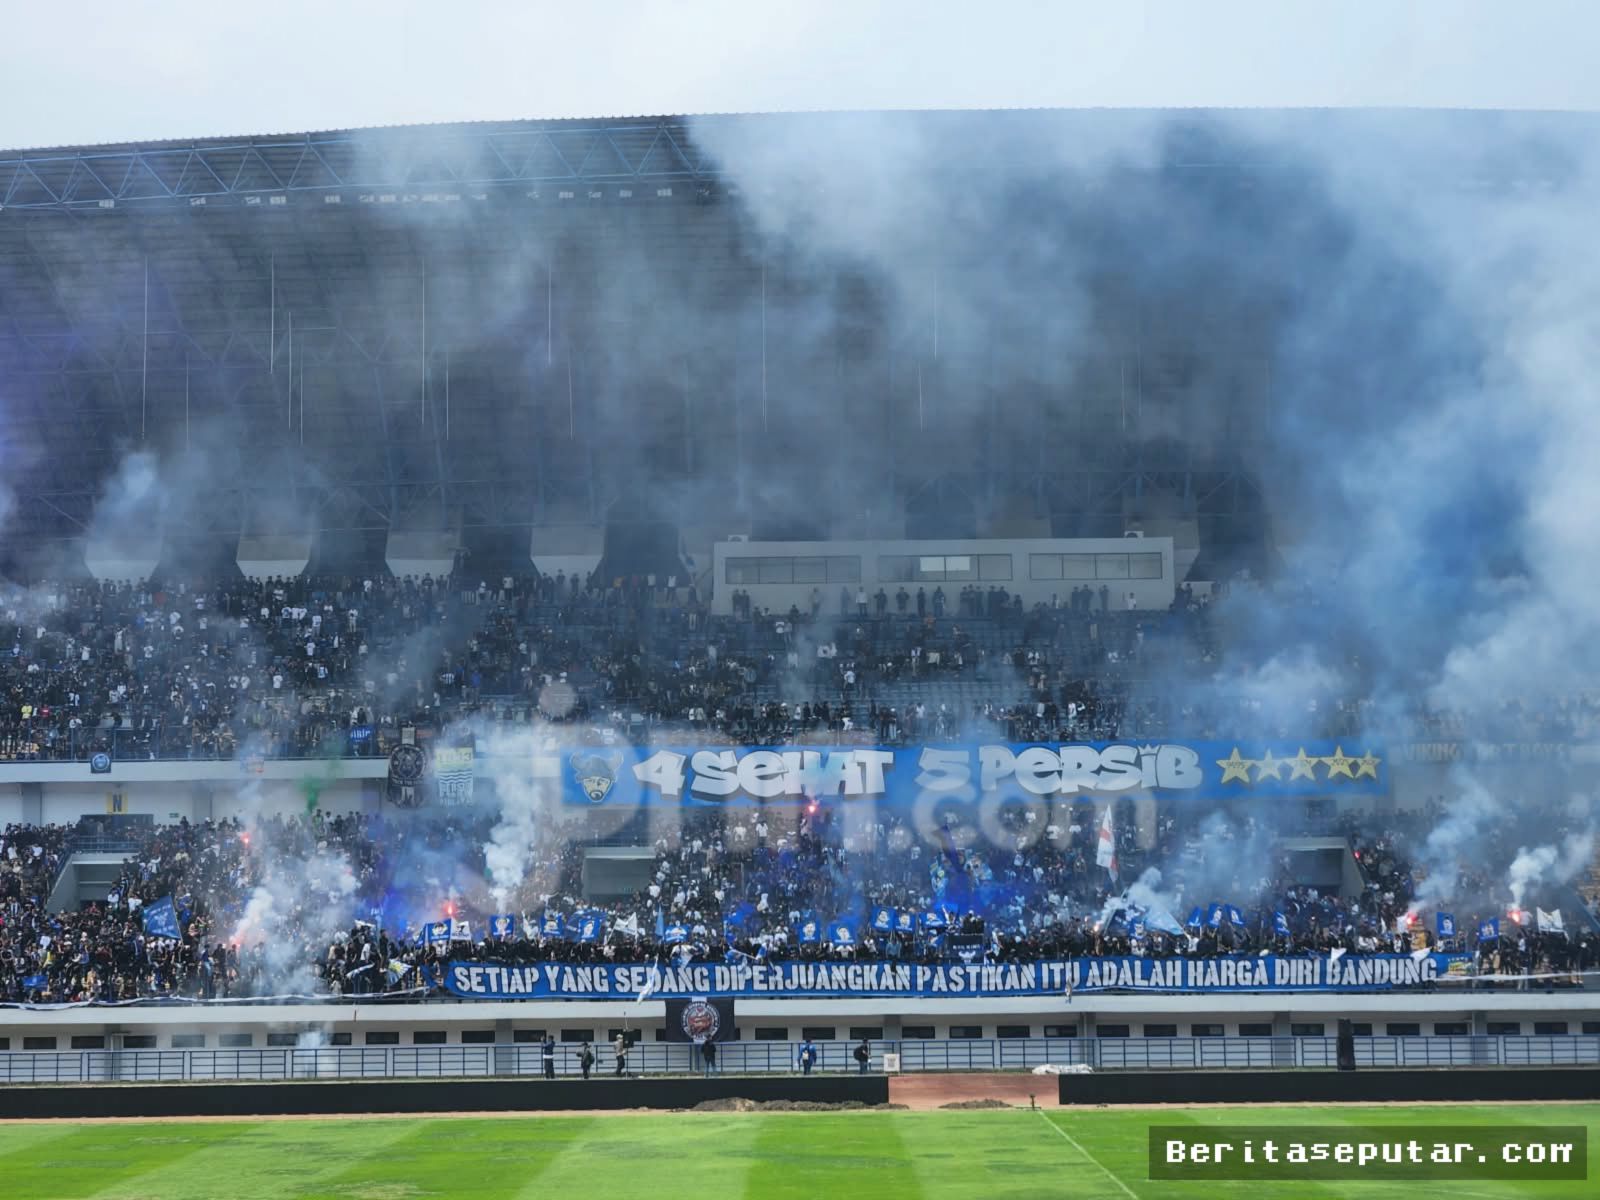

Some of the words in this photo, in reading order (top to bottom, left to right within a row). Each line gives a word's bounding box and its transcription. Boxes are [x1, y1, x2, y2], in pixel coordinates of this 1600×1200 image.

[632, 750, 687, 796] 4
[914, 747, 969, 791] 5
[454, 966, 540, 994] SETIAP
[544, 965, 609, 993] YANG
[615, 966, 710, 993] SEDANG
[715, 963, 910, 992] DIPERJUANGKAN
[916, 964, 1036, 992] PASTIKAN
[1042, 961, 1080, 989] ITU
[1086, 959, 1182, 987] ADALAH
[1187, 959, 1268, 987] HARGA
[1275, 958, 1320, 986] DIRI
[1326, 958, 1438, 986] BANDUNG
